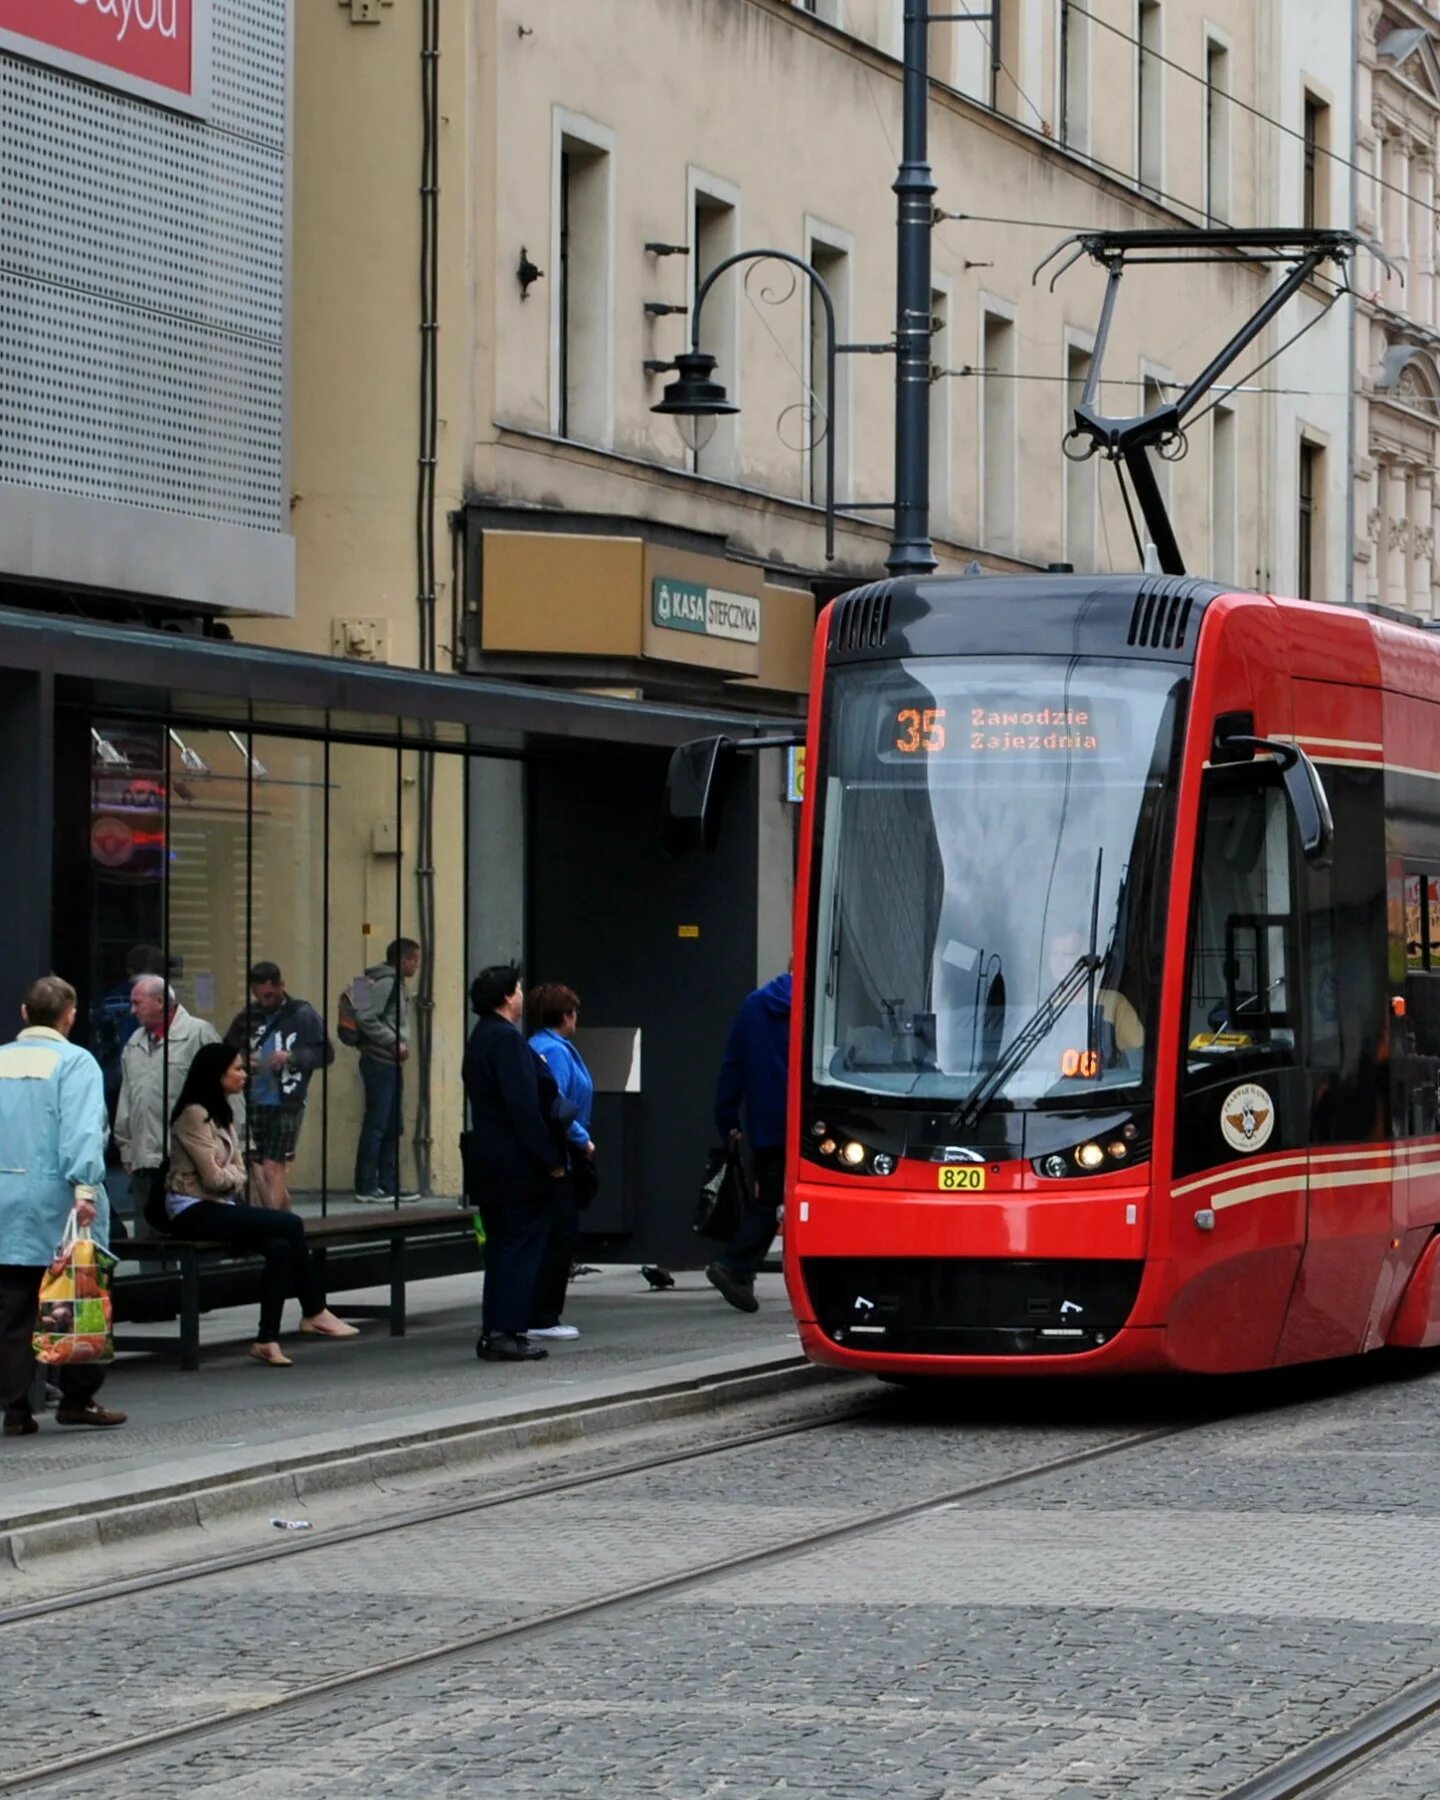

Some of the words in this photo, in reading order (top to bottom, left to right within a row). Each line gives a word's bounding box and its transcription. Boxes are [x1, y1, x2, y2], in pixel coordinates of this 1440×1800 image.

[673, 592, 704, 621] KASA
[709, 600, 757, 632] STEFCZYKA
[971, 708, 1089, 726] Zawodzie
[897, 709, 946, 752] 35
[970, 731, 1097, 750] Zajezdnia
[944, 1170, 981, 1188] 820
